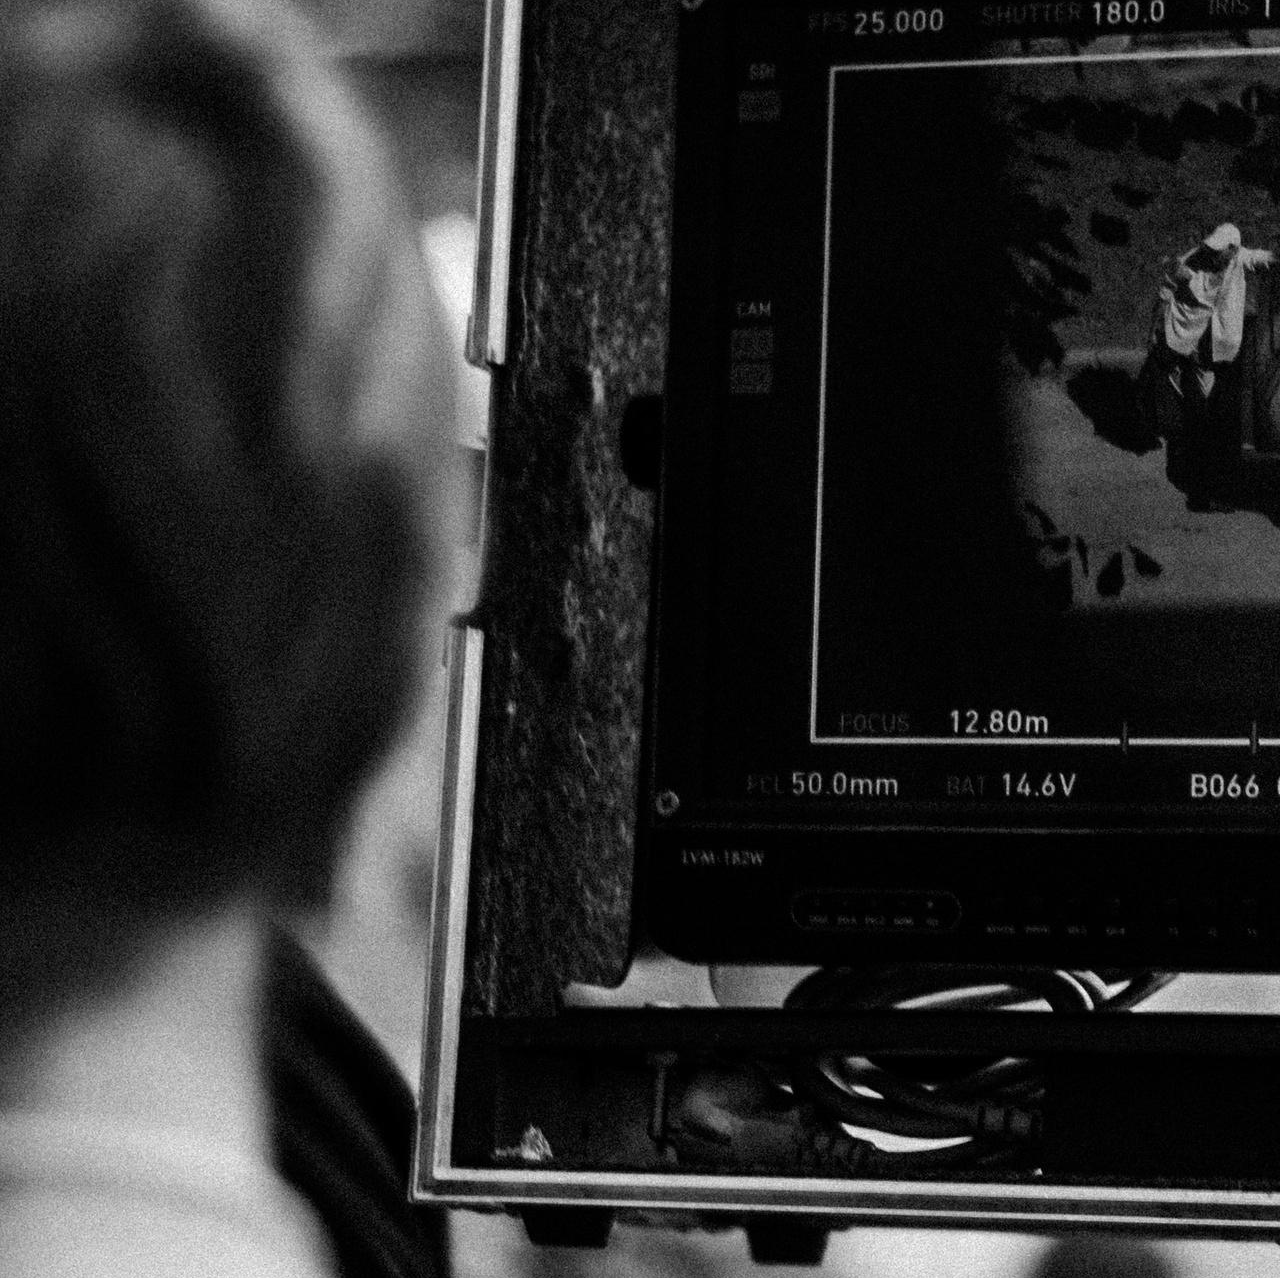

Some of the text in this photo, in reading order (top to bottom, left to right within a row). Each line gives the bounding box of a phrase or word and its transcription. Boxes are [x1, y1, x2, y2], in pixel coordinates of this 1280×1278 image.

[854, 7, 945, 36] 25.000
[981, 0, 1083, 26] SHUTTER
[735, 299, 772, 319] CAM
[839, 708, 1050, 735] FOCUS 12.80m
[791, 769, 900, 798] 50.0mm
[946, 772, 1078, 798] BAT 14.6V
[1190, 773, 1260, 800] B066
